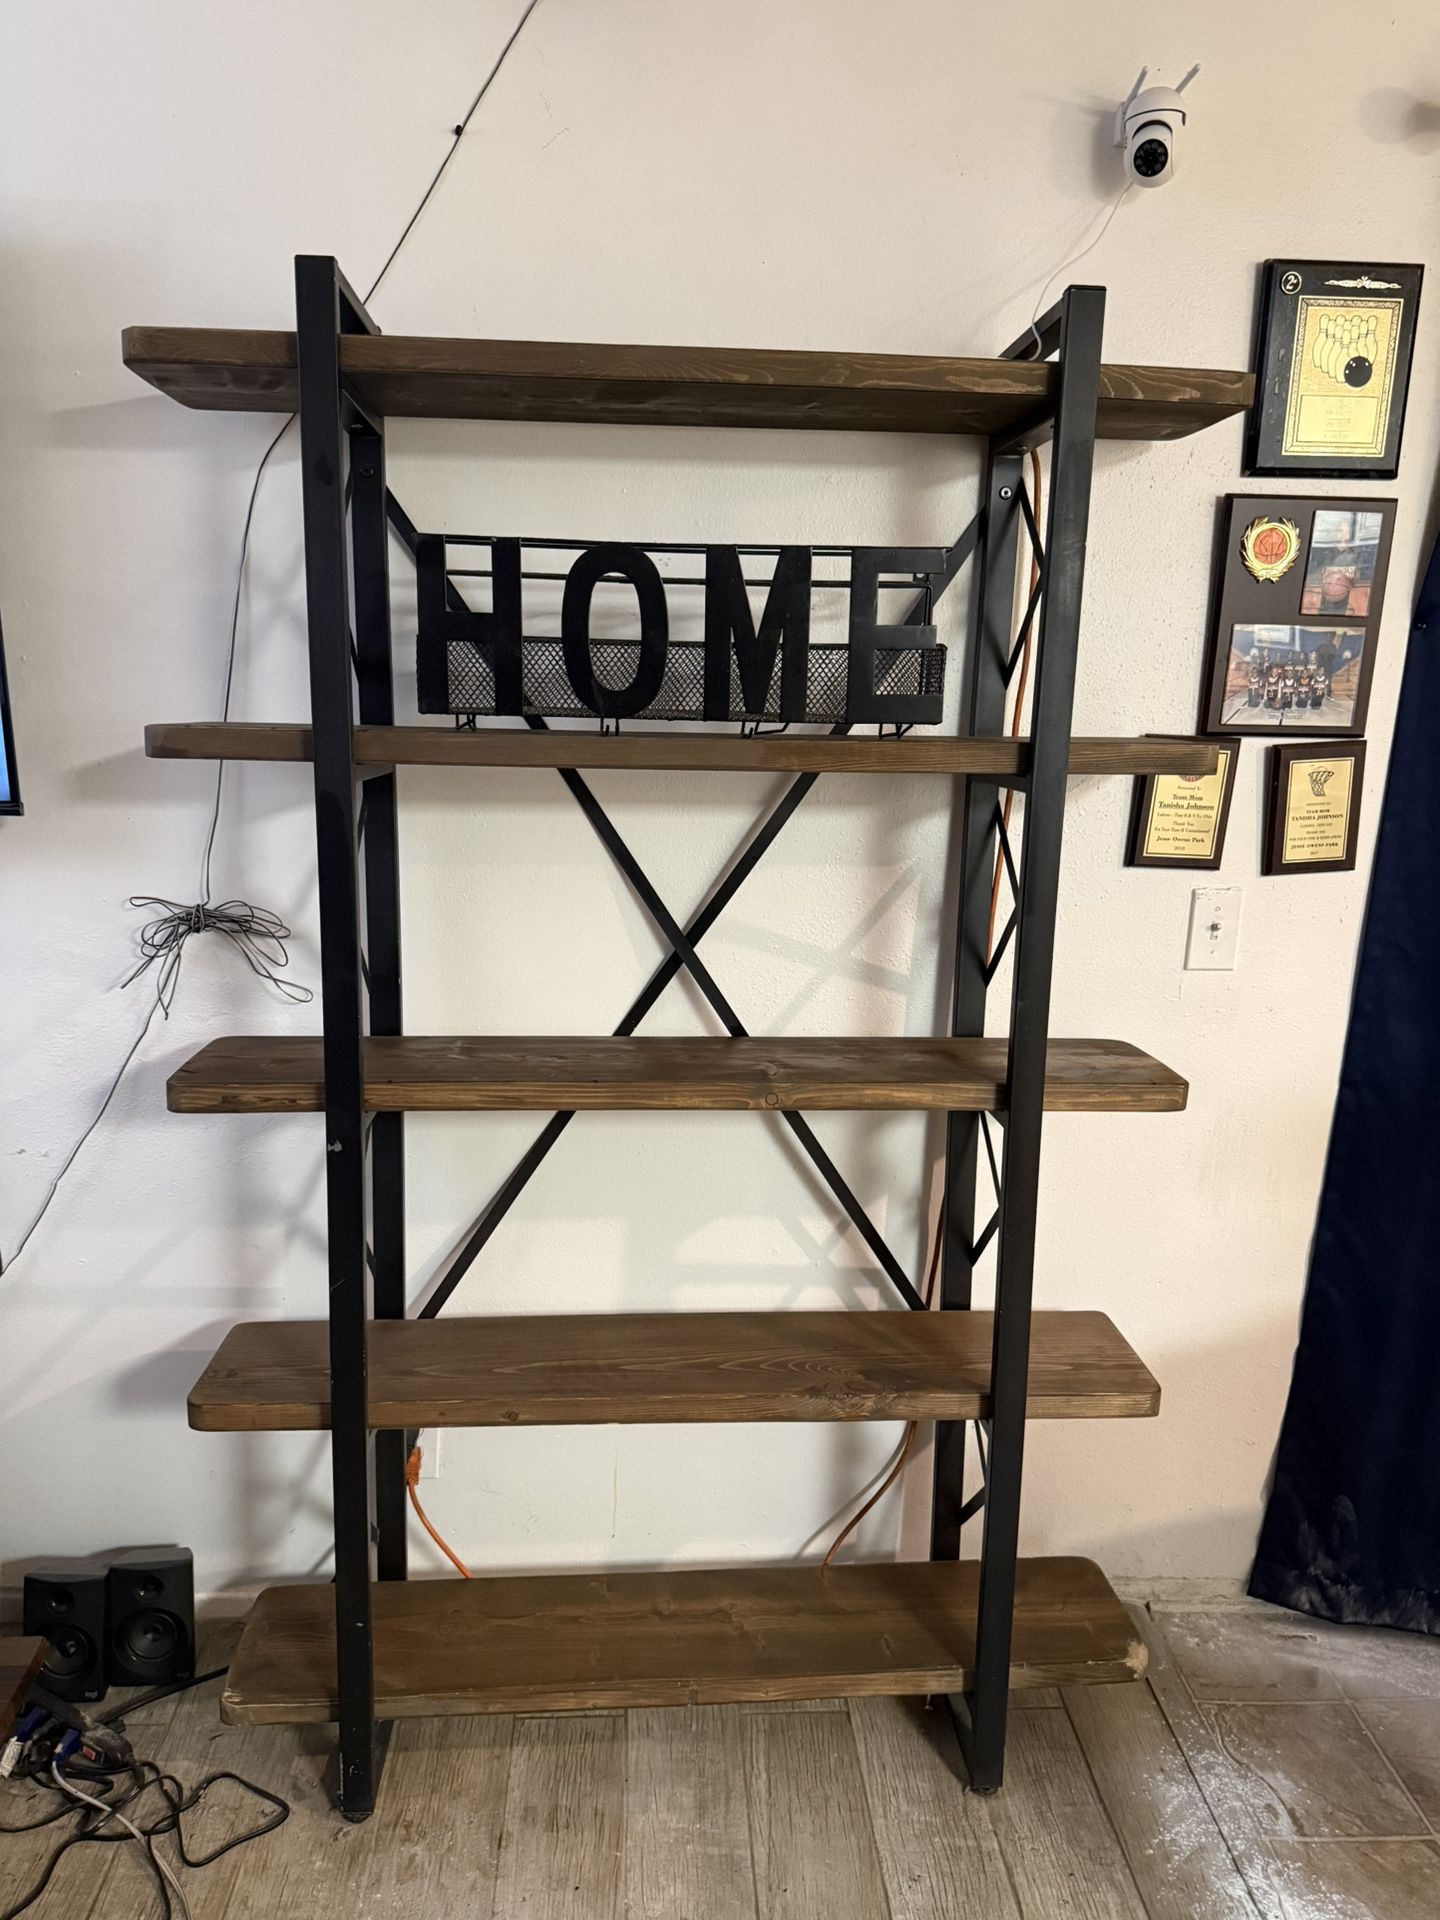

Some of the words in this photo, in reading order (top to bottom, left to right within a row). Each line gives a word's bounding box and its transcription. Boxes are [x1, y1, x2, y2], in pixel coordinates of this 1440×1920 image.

[1286, 275, 1298, 290] 2
[416, 534, 948, 725] HOME
[1185, 802, 1214, 811] Johnson
